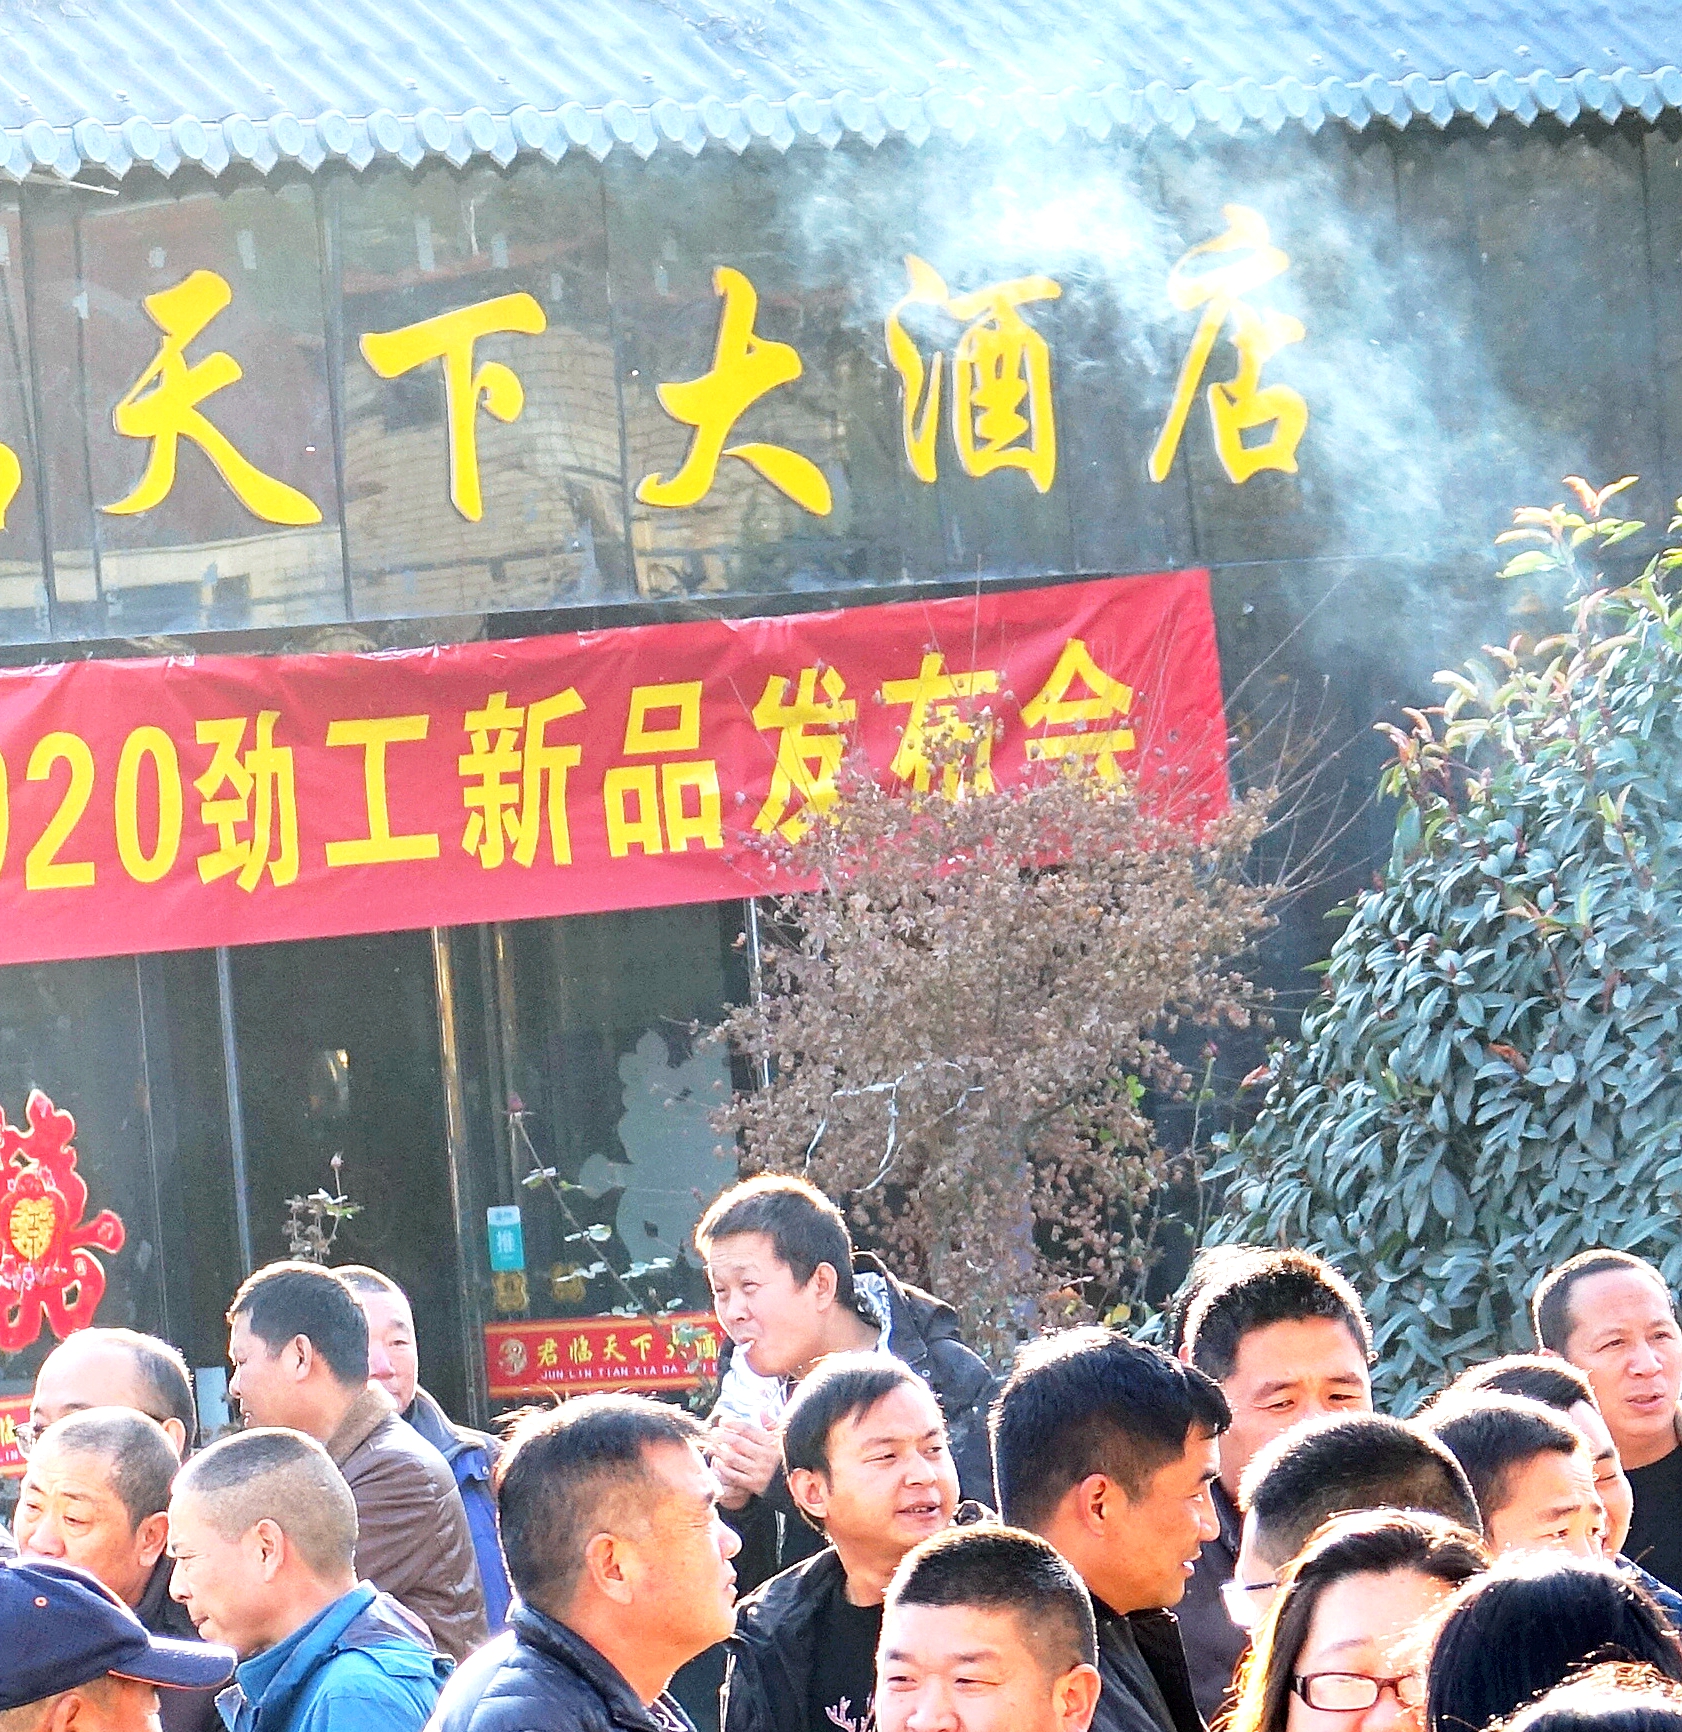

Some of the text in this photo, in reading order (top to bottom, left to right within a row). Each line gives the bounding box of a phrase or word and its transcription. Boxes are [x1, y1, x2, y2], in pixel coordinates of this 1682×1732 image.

[541, 1369, 564, 1380] JUN
[634, 1365, 657, 1375] XIA
[662, 1364, 678, 1374] DA
